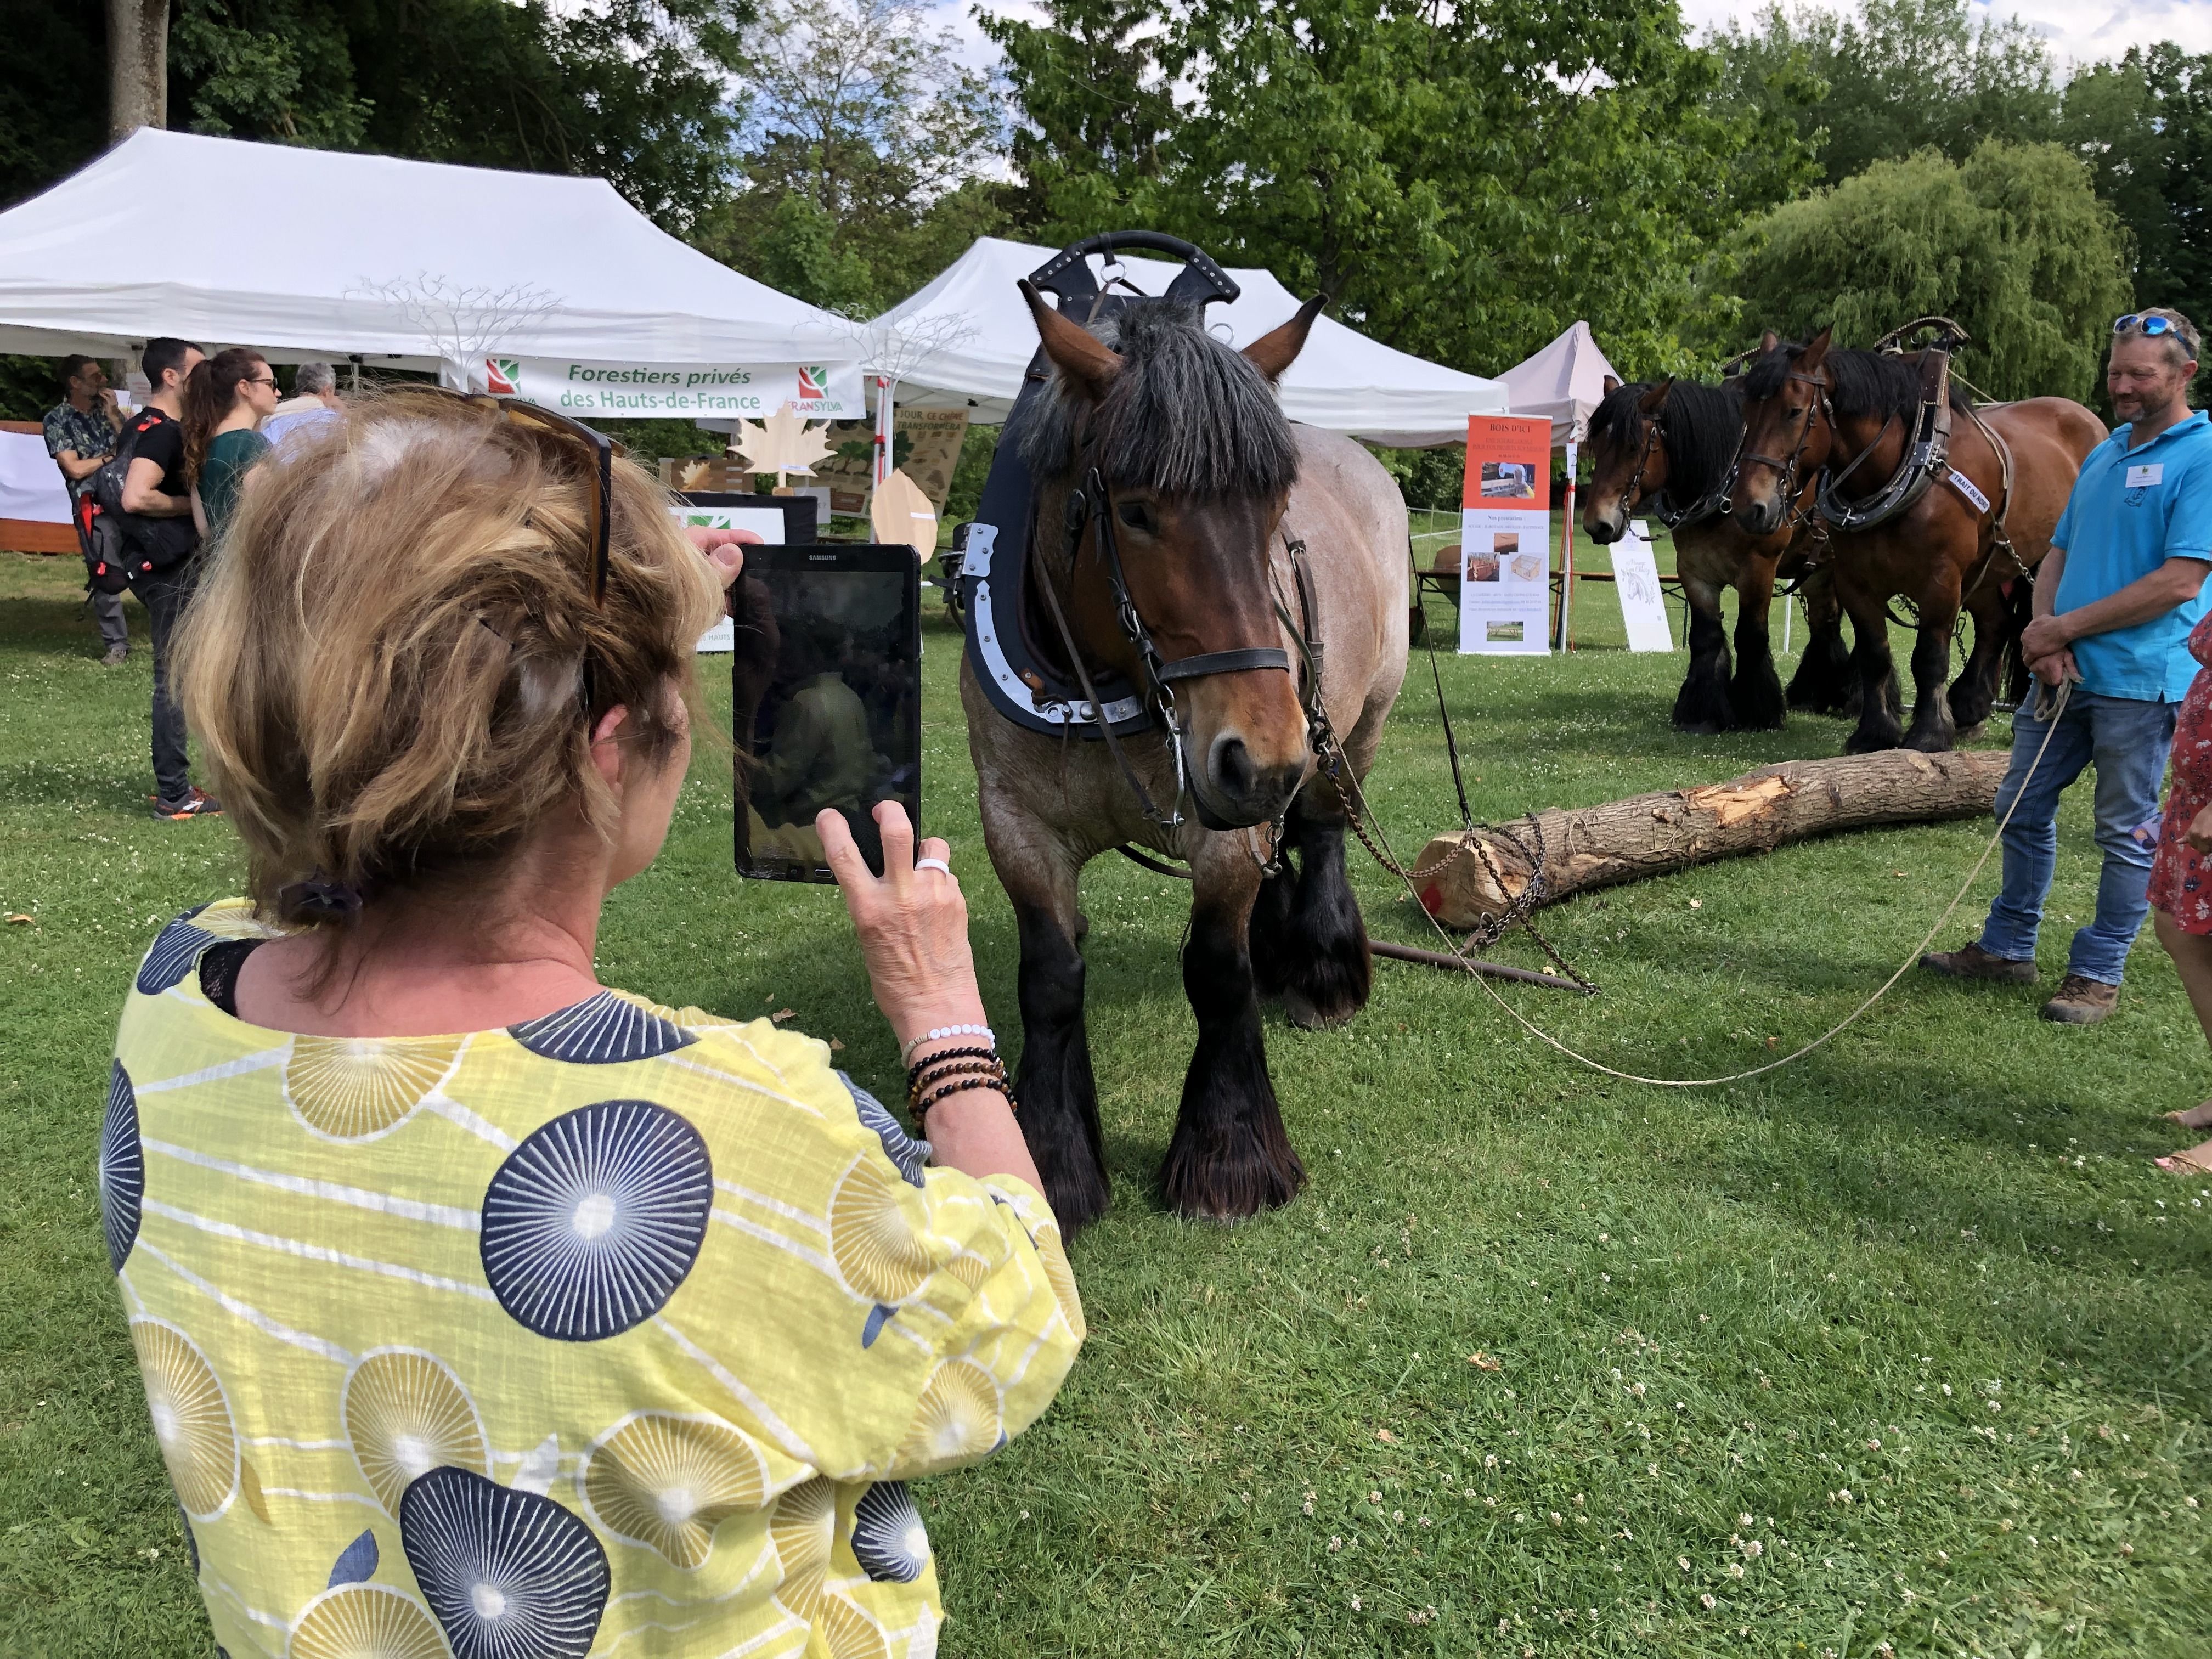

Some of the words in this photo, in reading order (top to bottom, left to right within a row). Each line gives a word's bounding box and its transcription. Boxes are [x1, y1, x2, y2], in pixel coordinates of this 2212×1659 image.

[569, 364, 681, 385] Forestiers
[687, 367, 752, 388] privés
[560, 389, 595, 408] des
[600, 391, 761, 410] Hauts-de-France
[927, 412, 937, 420] CE
[1490, 424, 1509, 432] BOIS
[1955, 475, 1971, 490] TRAIT
